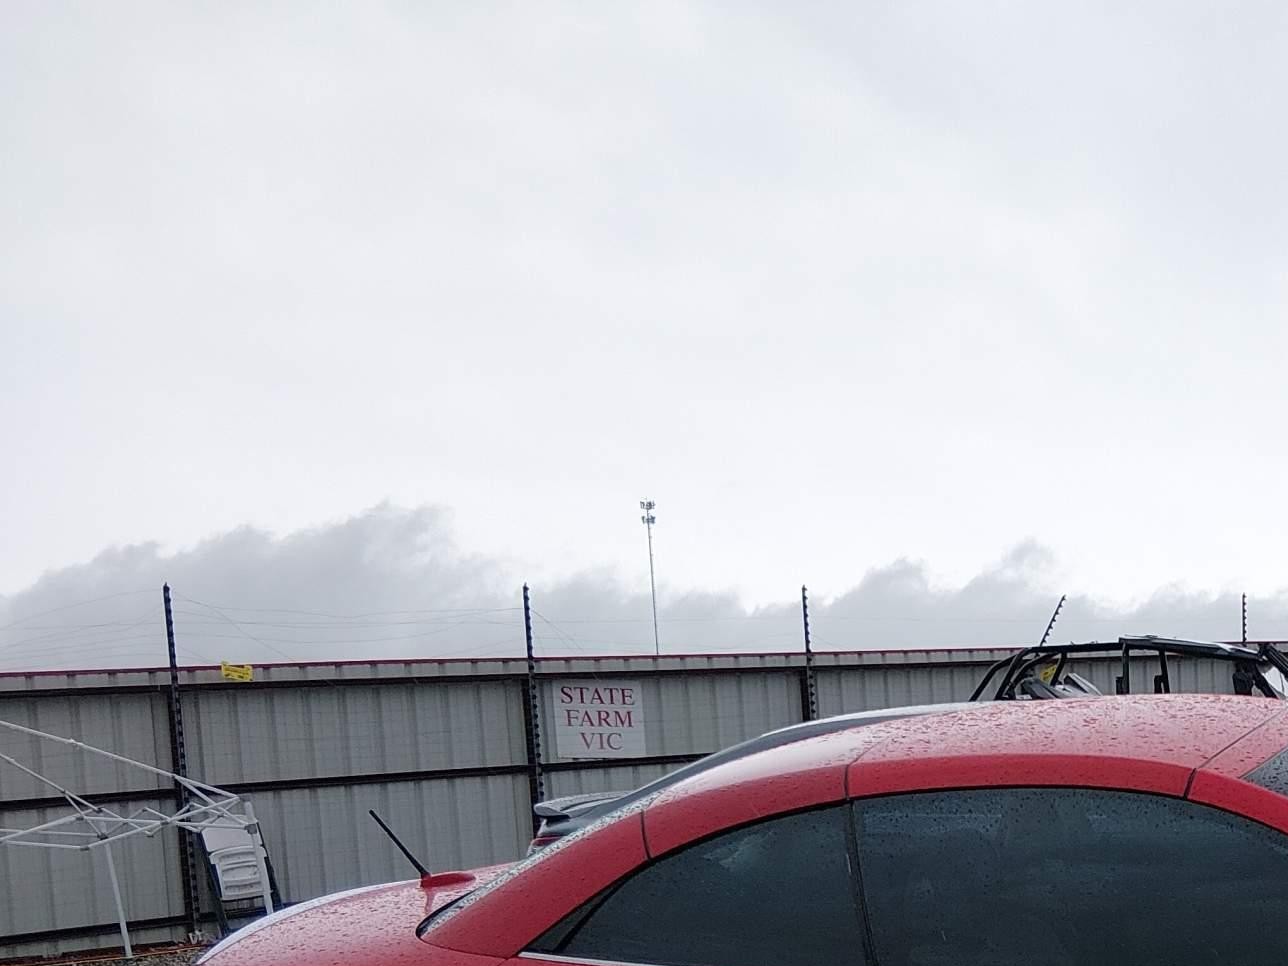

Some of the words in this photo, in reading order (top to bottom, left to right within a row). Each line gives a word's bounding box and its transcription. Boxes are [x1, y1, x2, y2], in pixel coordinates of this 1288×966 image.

[560, 686, 635, 705] STATE
[566, 709, 634, 728] FARM
[580, 732, 623, 750] VIC
